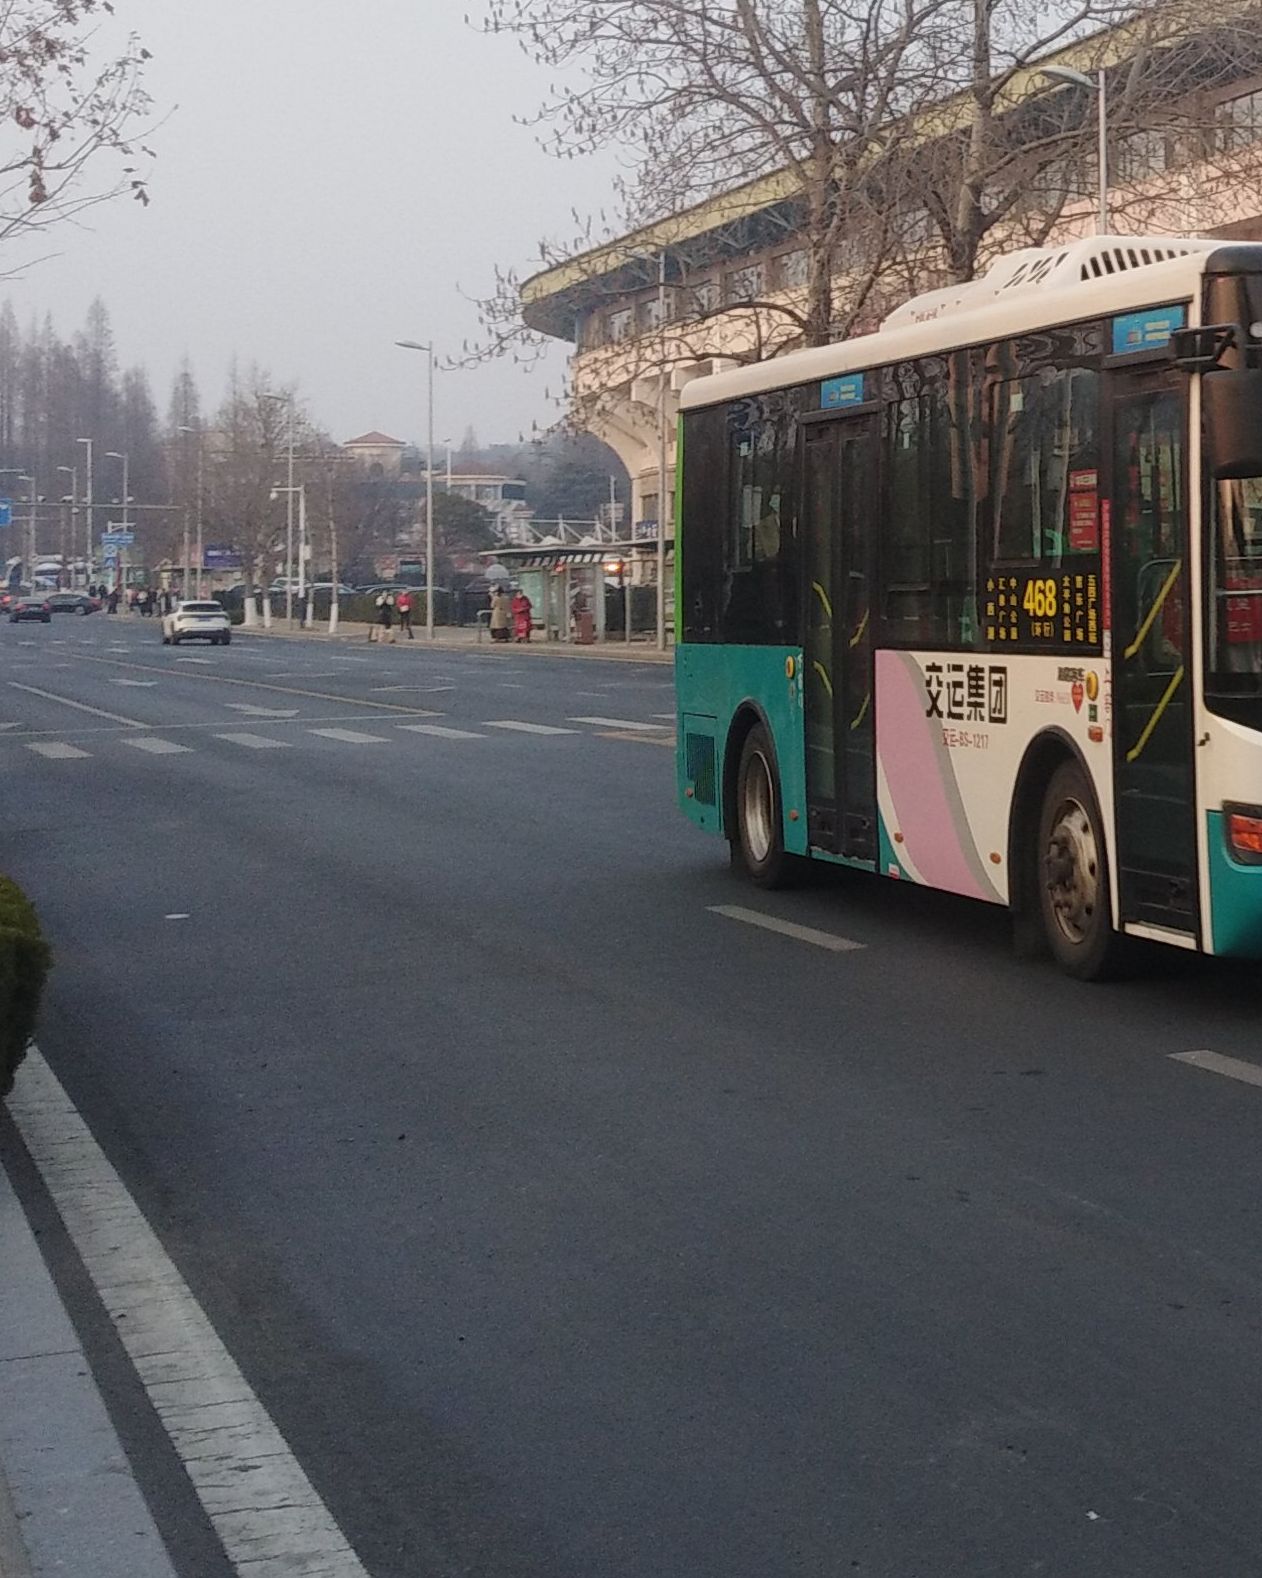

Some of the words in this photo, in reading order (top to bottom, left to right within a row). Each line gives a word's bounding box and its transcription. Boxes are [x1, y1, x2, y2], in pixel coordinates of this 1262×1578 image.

[1023, 578, 1057, 617] 468
[925, 662, 1008, 724] 交运集团
